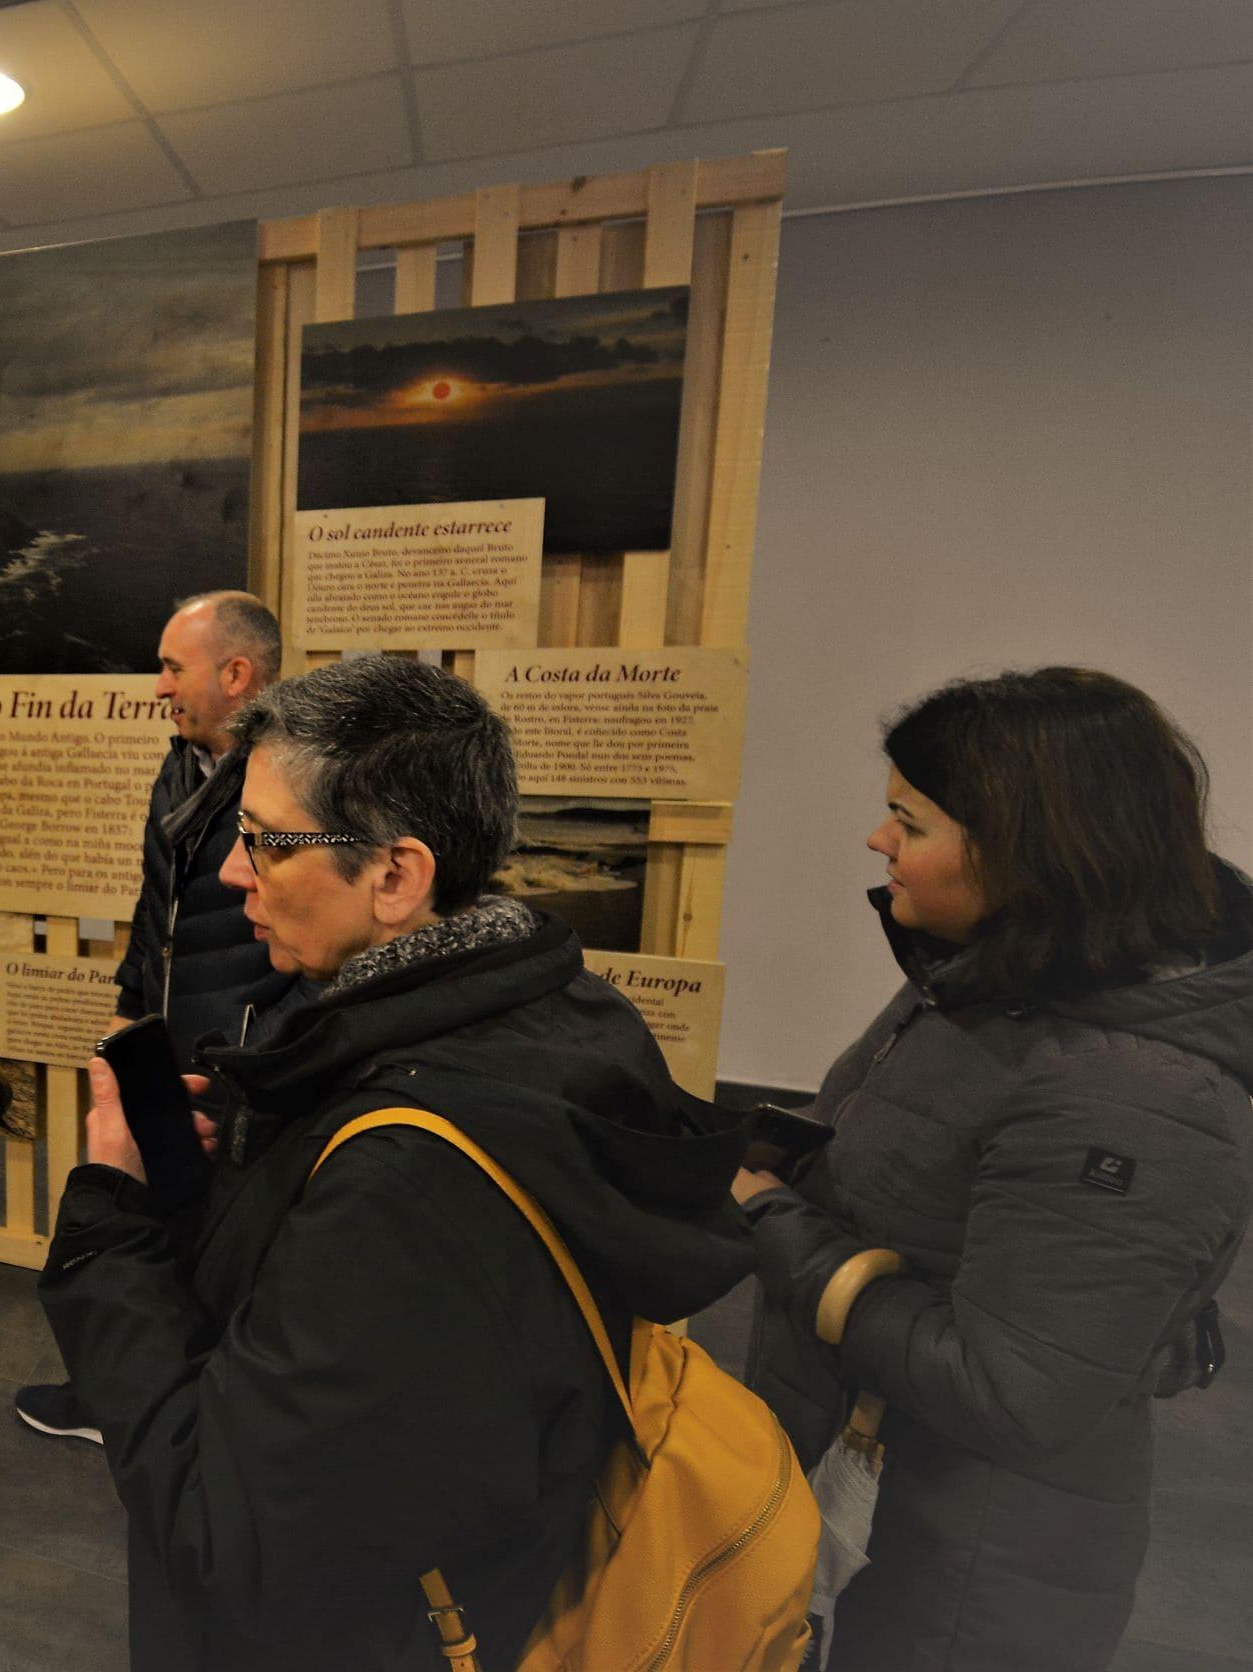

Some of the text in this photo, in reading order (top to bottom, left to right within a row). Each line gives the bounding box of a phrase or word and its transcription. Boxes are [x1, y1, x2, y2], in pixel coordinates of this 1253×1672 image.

[309, 518, 512, 542] O sol candente estarrece
[504, 664, 681, 683] A Costa da Morte
[8, 691, 53, 720] Fin
[60, 690, 93, 720] da
[9, 727, 48, 740] Mundo
[108, 731, 160, 747] primeiro
[66, 743, 118, 758] Gallaecia
[122, 747, 140, 758] viu
[83, 774, 131, 793] Portugal
[15, 879, 53, 892] sempre
[6, 962, 18, 976] O
[67, 968, 85, 982] do
[626, 970, 702, 997] Europa
